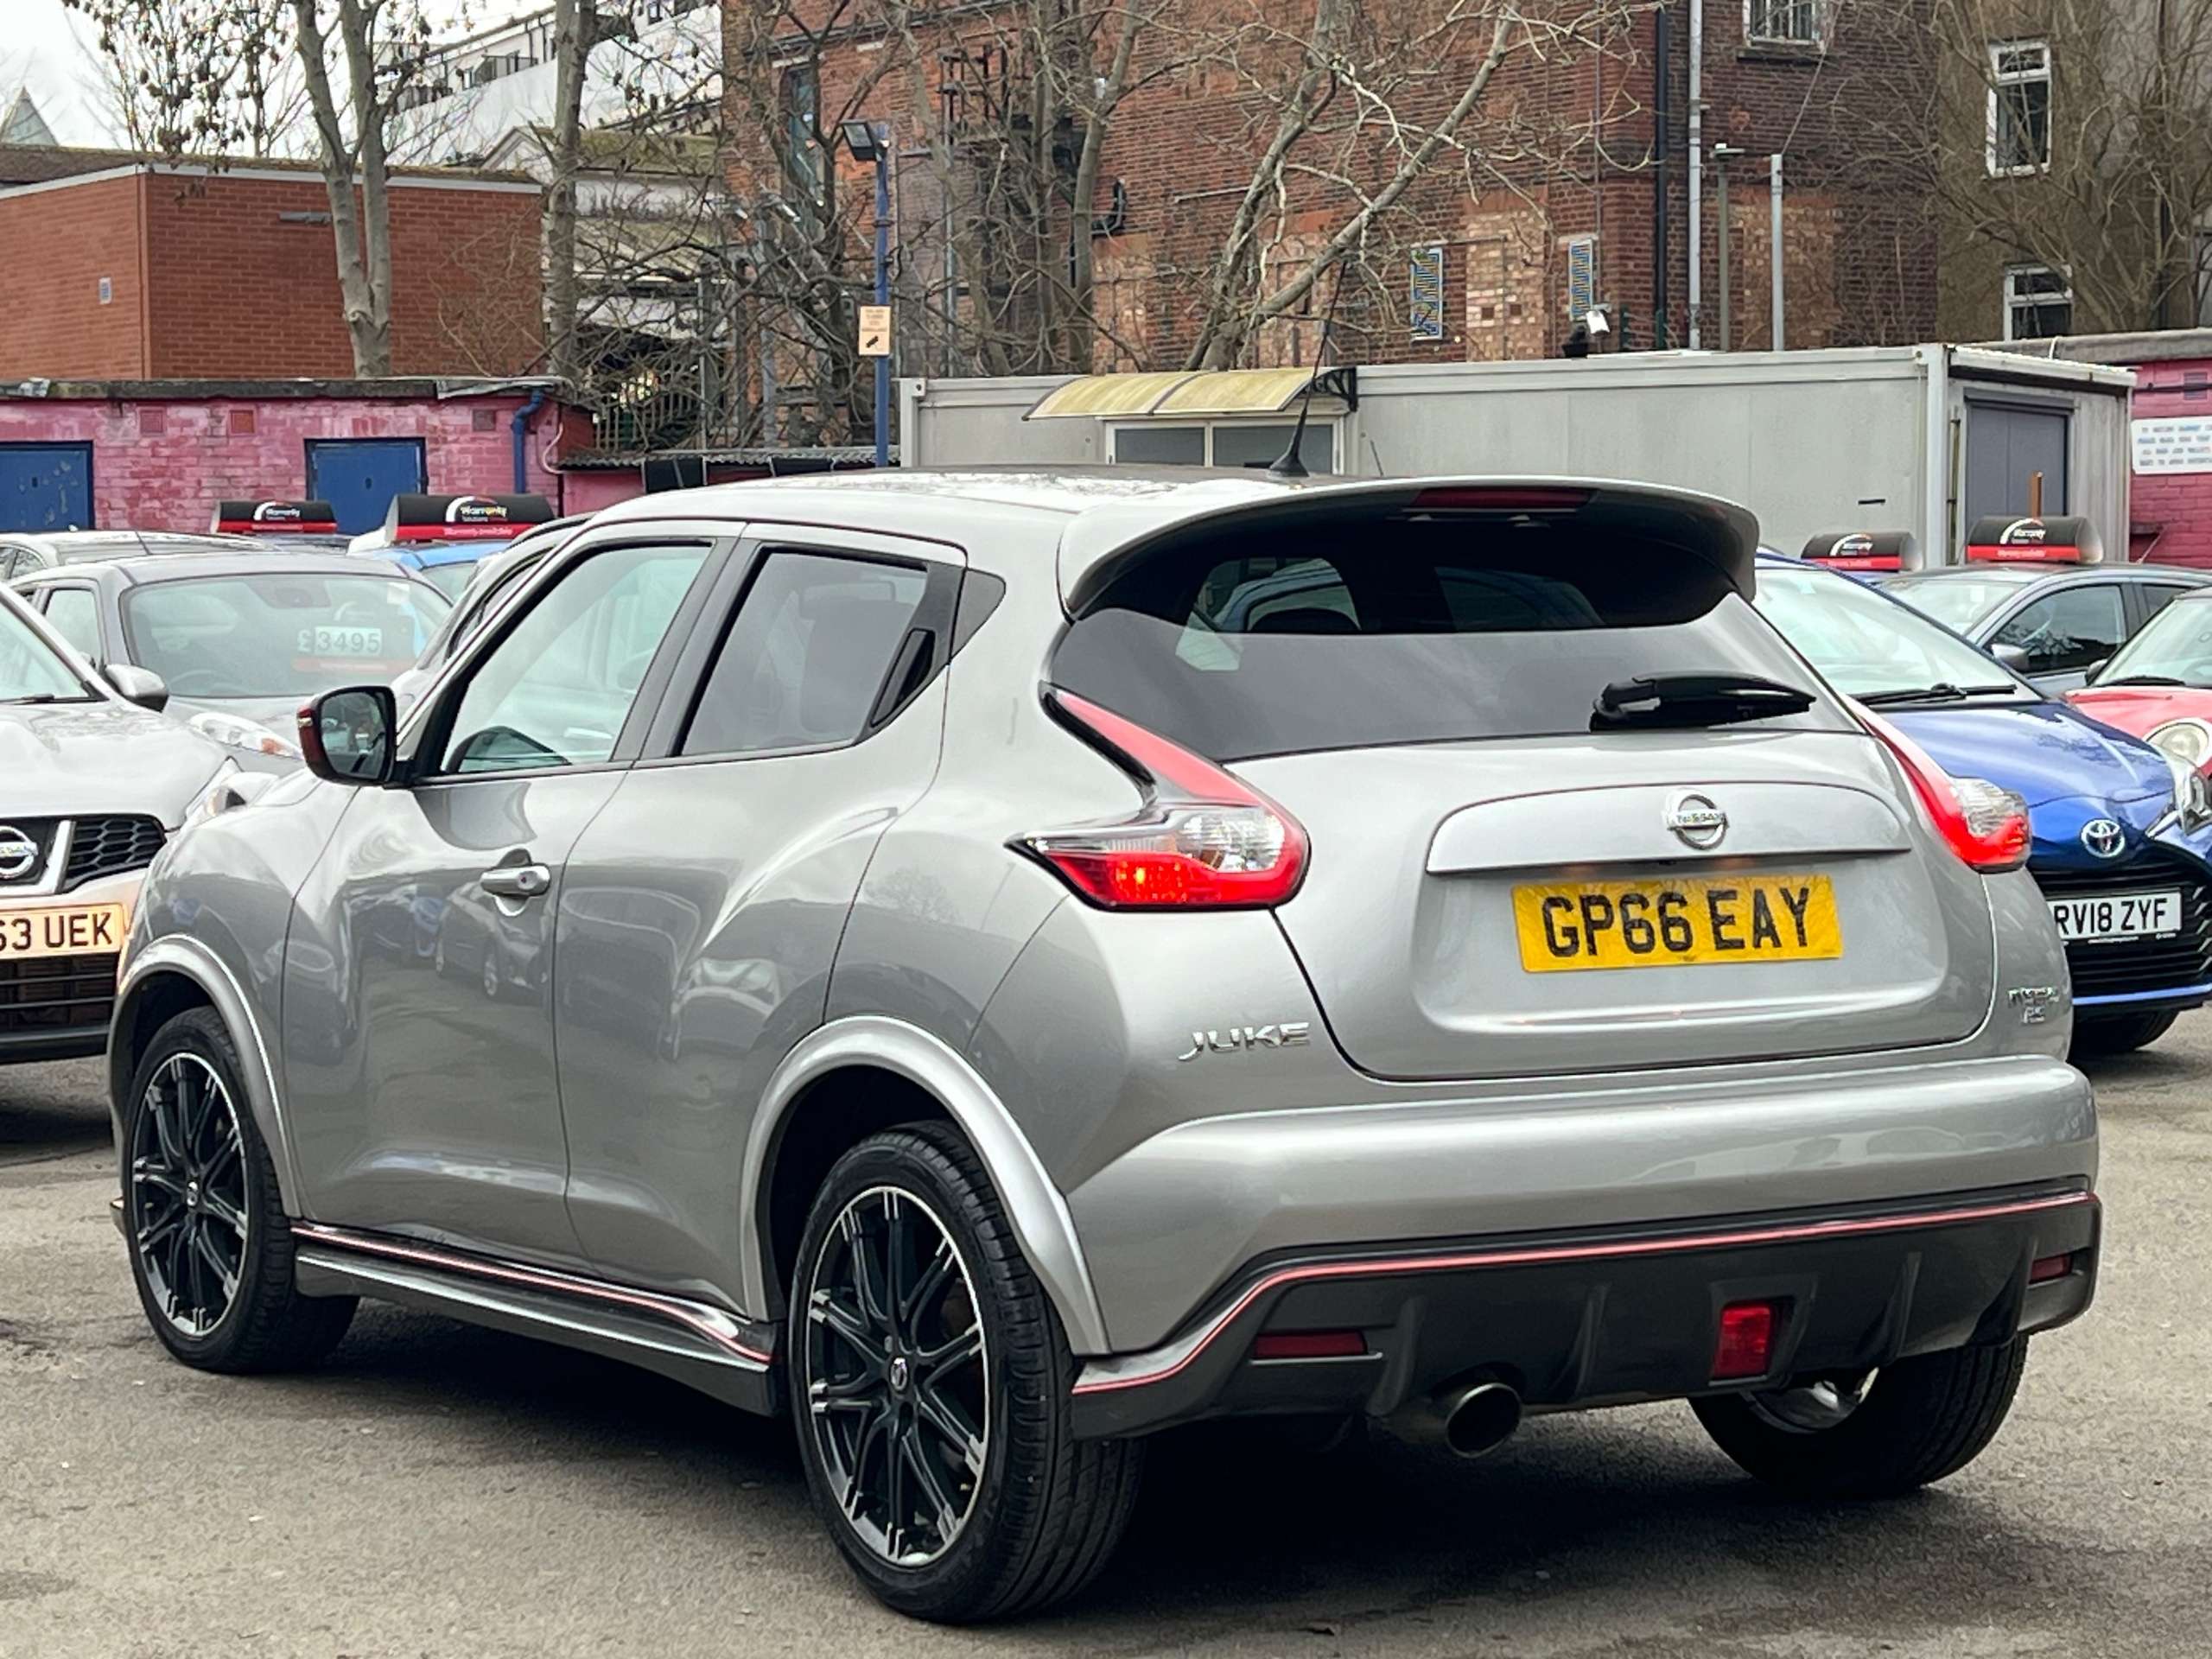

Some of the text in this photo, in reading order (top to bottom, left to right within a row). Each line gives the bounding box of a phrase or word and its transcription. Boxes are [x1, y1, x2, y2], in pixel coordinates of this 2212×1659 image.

[297, 629, 381, 654] £3495
[44, 912, 112, 948] UEK
[1541, 887, 1810, 958] GP66 EAY
[2054, 898, 2168, 935] RV18 ZYF
[1178, 1022, 1310, 1062] JUKE
